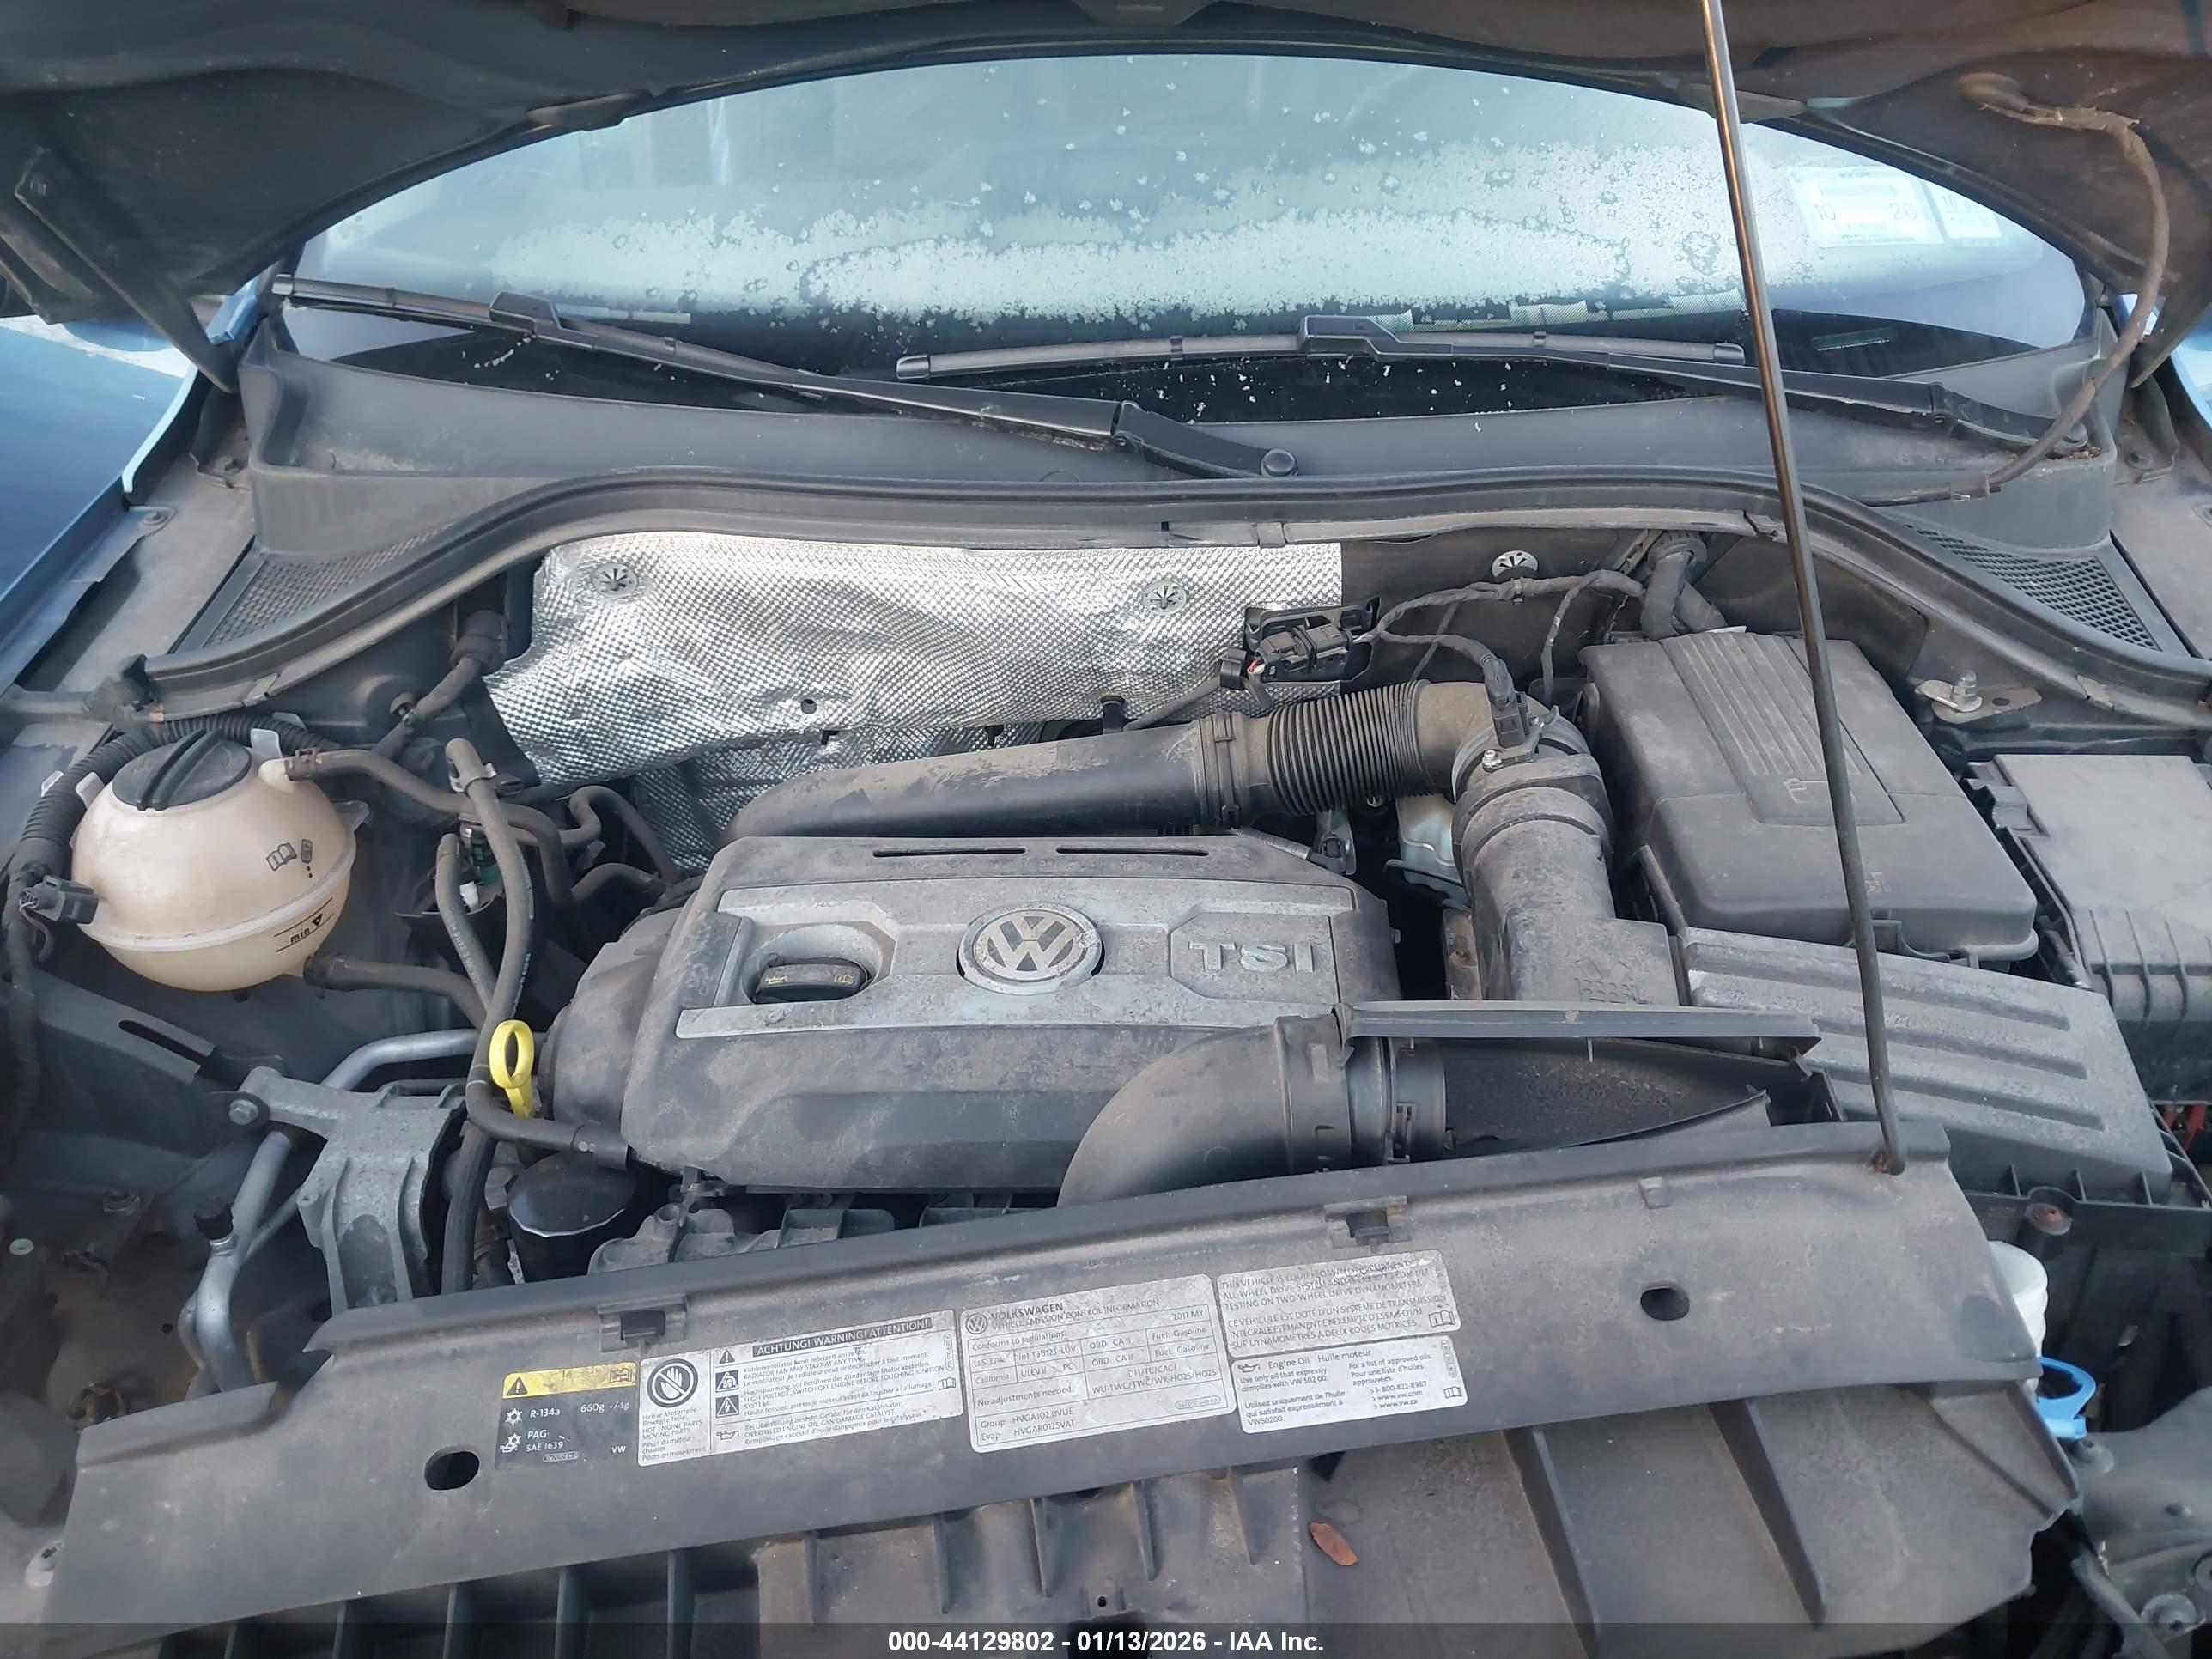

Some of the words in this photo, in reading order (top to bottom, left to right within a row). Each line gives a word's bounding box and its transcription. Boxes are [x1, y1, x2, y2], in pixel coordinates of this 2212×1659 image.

[1814, 203, 1837, 221] 10
[1889, 201, 1917, 221] 26
[290, 927, 310, 943] min
[1186, 939, 1315, 974] TSI
[1223, 1291, 1236, 1300] ALL
[1238, 1287, 1267, 1297] WHEEL
[1269, 1284, 1296, 1294] DRIVE
[1224, 1298, 1259, 1310] TESTING
[1260, 1297, 1274, 1306] ON
[1276, 1290, 1327, 1304] TWO-WHEEL
[1328, 1287, 1353, 1297] DRIVE
[990, 1302, 1064, 1322] VOLKSWAGEN
[992, 1319, 1024, 1331] VEHICLE
[1024, 1313, 1063, 1326] EMISSION
[1065, 1307, 1101, 1320] CONTROL
[1103, 1298, 1159, 1314] INFORMATION
[1172, 1310, 1190, 1321] 2017
[1190, 1309, 1204, 1318] MY
[1227, 1318, 1237, 1327] CE
[1279, 1311, 1293, 1321] EST
[1375, 1300, 1387, 1310] DE
[813, 1329, 866, 1346] WARNING!
[1173, 1325, 1207, 1337] Gasoline
[1231, 1339, 1248, 1349] SUR
[1324, 1327, 1347, 1338] DEUX
[1348, 1323, 1376, 1334] ROUES
[1376, 1318, 1418, 1331] MOTRICES
[1011, 1336, 1020, 1345] to
[1112, 1337, 1124, 1346] CA
[1176, 1341, 1210, 1353] Gasoline
[1115, 1354, 1127, 1363] CA
[1267, 1358, 1297, 1371] Engine
[1297, 1356, 1310, 1365] Oil
[1316, 1352, 1340, 1363] Huile
[1340, 1348, 1371, 1360] moteur
[1386, 1354, 1418, 1365] approved
[744, 1369, 773, 1380] RADIATOR
[789, 1364, 803, 1373] MAY
[805, 1361, 824, 1370] START
[834, 1358, 847, 1366] ANY
[855, 1376, 879, 1385] BEFORE
[880, 1370, 914, 1381] TOUCHING
[915, 1364, 944, 1375] IGNITION
[880, 1365, 900, 1375] Motor
[1021, 1367, 1040, 1377] ULEV
[1253, 1373, 1269, 1383] only
[1295, 1366, 1328, 1377] expressly
[1350, 1370, 1366, 1378] Pour
[1396, 1363, 1424, 1372] d'huiles
[975, 1372, 1009, 1384] California
[1241, 1382, 1272, 1393] complies
[1273, 1379, 1289, 1388] with
[976, 1397, 989, 1406] No
[990, 1389, 1041, 1406] adjustments
[1244, 1399, 1270, 1409] Utilisez
[1271, 1394, 1313, 1407] uniquement
[1376, 1389, 1423, 1401] www.vw.com
[529, 1407, 561, 1419] R-134a
[580, 1402, 605, 1414] 660g
[1246, 1411, 1258, 1419] qui
[1258, 1407, 1285, 1416] satisfait
[1286, 1400, 1336, 1413] expressément
[1378, 1398, 1419, 1409] www.vw.ca
[658, 1422, 681, 1432] ENGINE
[684, 1419, 702, 1428] PARTS
[1012, 1419, 1076, 1437] HVGAR0125VAT
[526, 1429, 547, 1439] PAG
[642, 1431, 670, 1440] MOVING
[526, 1443, 542, 1452] SAE
[543, 1441, 563, 1450] J639
[611, 1445, 626, 1454] VW
